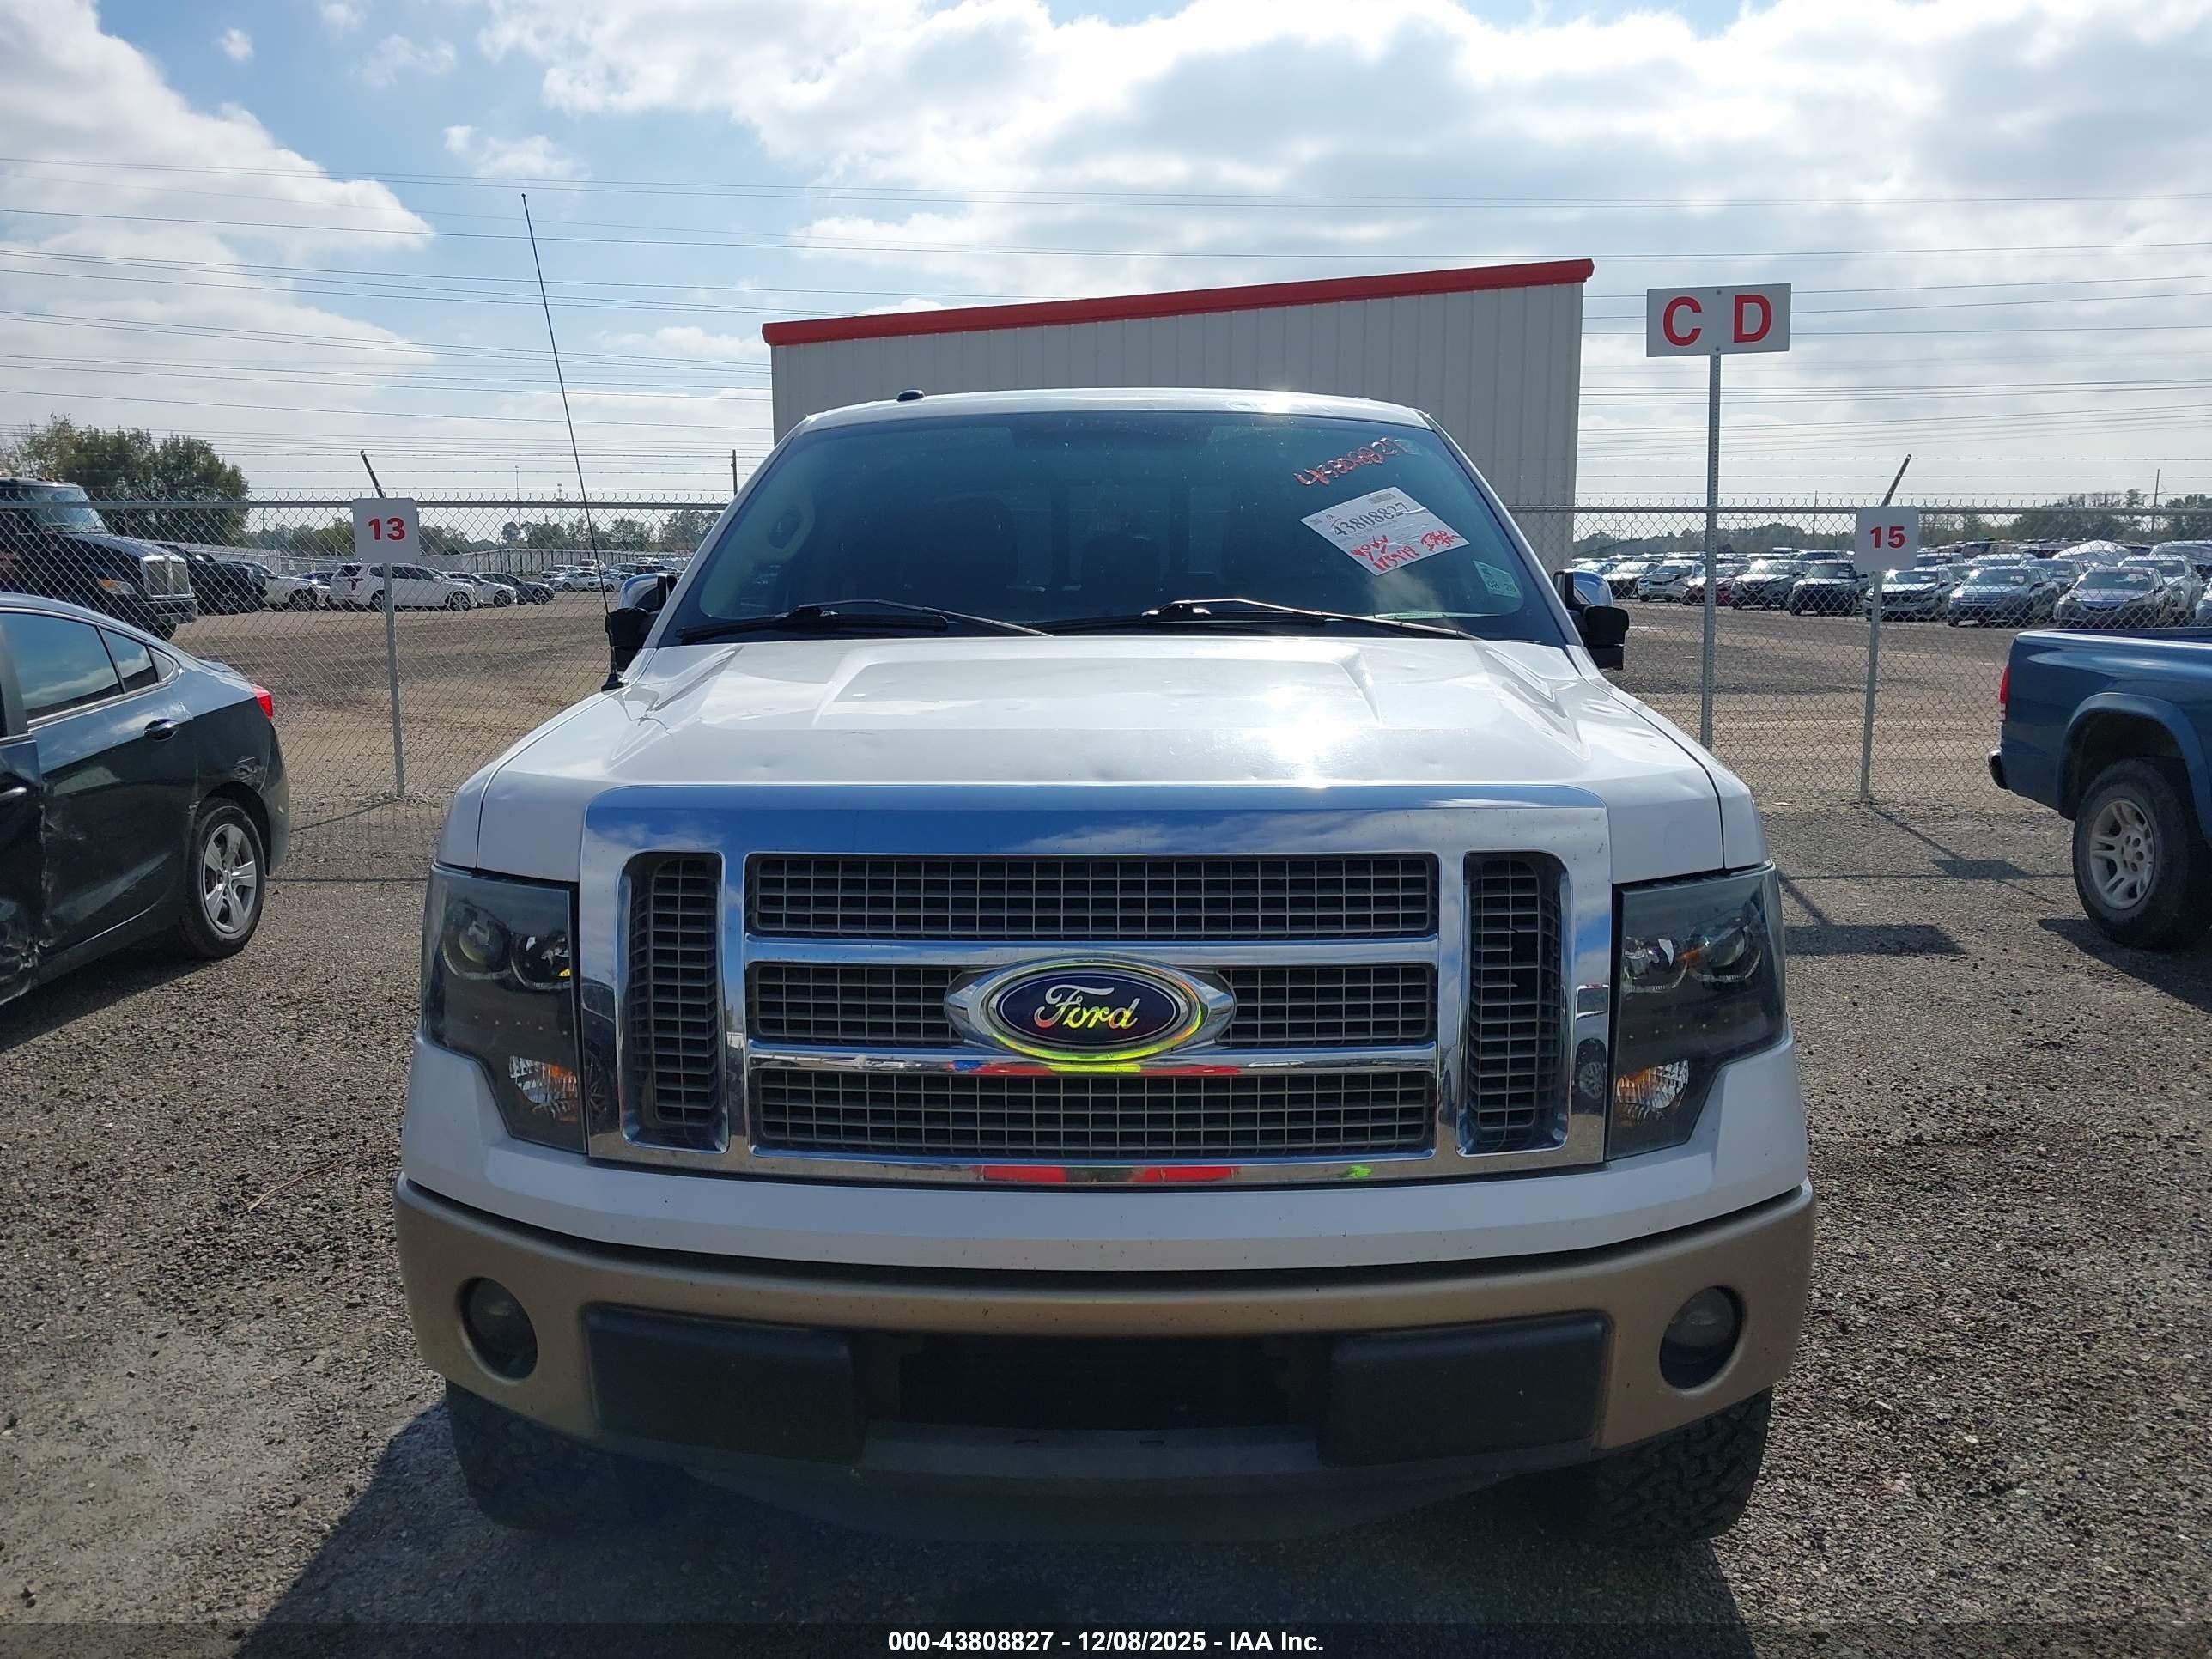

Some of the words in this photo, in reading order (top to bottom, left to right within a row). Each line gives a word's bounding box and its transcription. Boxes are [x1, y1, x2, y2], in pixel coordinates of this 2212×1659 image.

[1663, 295, 1703, 348] C
[1733, 293, 1772, 343] D
[368, 517, 405, 541] 13
[1333, 501, 1410, 537] 43808827
[1869, 526, 1905, 549] 15
[1033, 984, 1141, 1030] Ford
